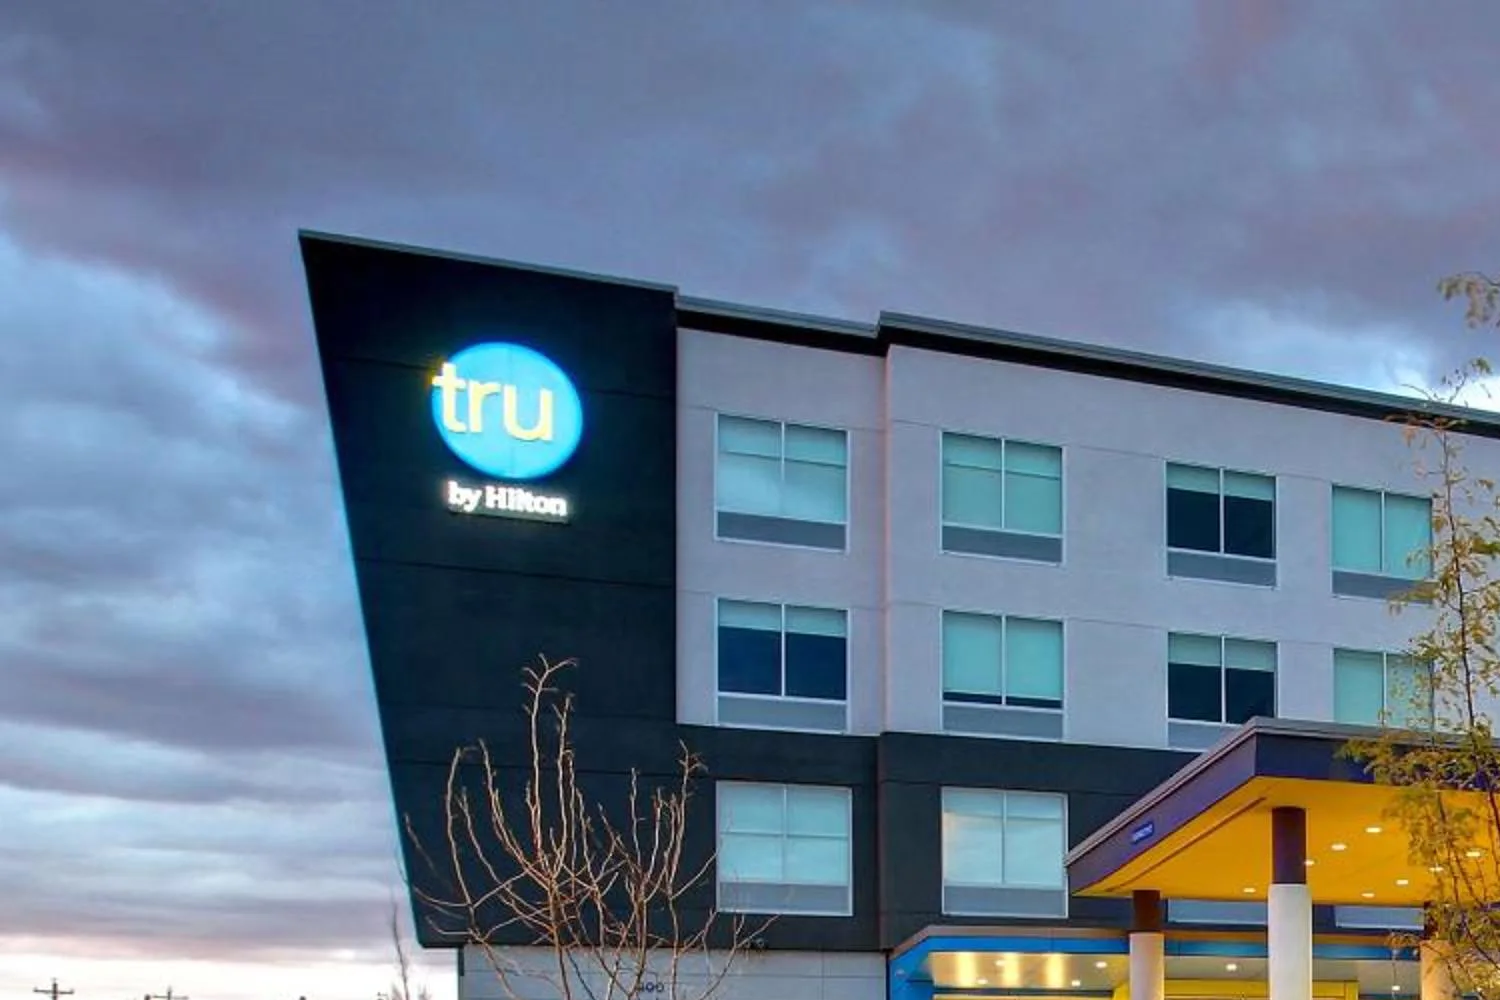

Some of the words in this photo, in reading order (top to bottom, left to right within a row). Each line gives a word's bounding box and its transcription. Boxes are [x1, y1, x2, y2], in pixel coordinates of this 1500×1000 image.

[431, 362, 554, 441] tru
[447, 480, 481, 512] by
[485, 485, 567, 517] Hilton
